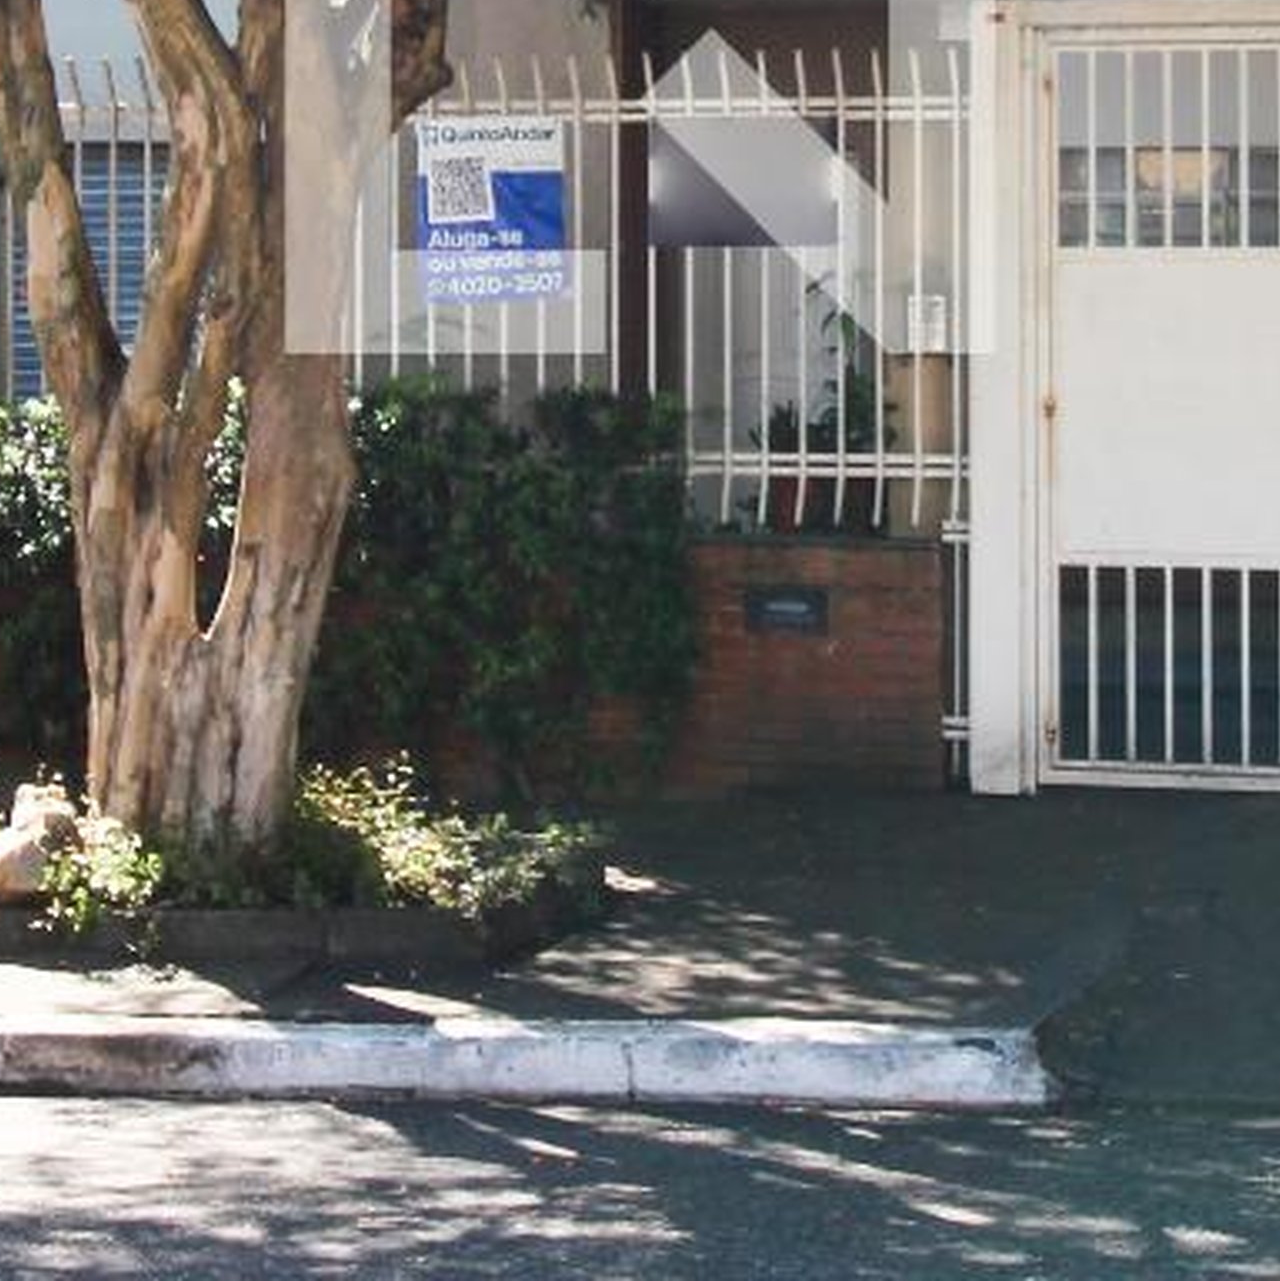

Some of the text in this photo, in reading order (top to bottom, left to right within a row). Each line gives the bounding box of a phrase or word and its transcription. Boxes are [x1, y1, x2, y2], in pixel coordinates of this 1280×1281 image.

[441, 126, 555, 142] QuintoAndar
[429, 230, 523, 248] Aluga-se
[429, 251, 561, 273] ou vende-se
